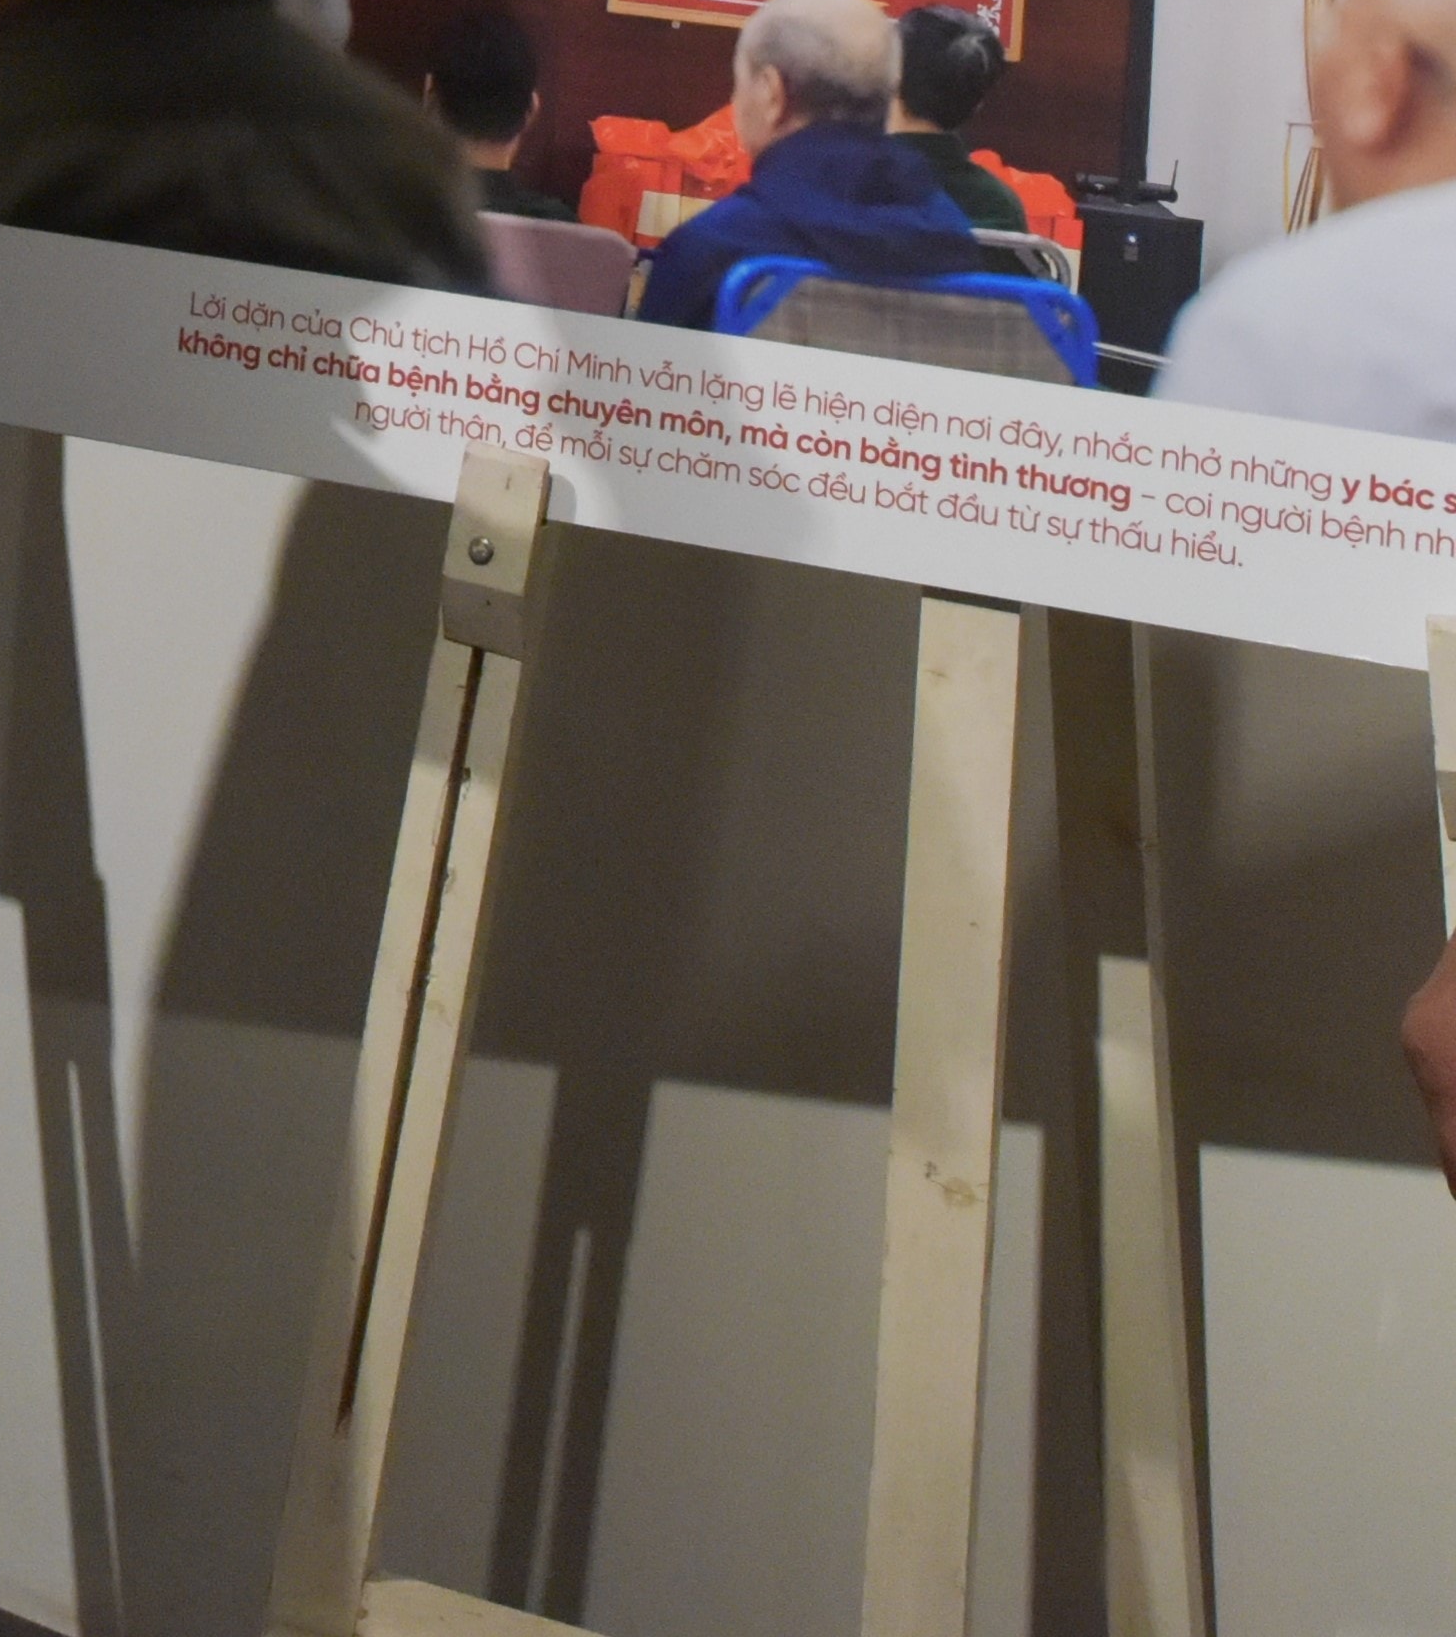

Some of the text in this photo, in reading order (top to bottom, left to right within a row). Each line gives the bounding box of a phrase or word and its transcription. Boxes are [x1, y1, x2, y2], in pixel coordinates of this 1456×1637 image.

[177, 326, 261, 371] không
[267, 344, 308, 372] chỉ
[312, 351, 381, 384] chữa
[387, 360, 458, 397] bệnh
[464, 372, 540, 416] bằng
[547, 389, 652, 428] chuyên
[659, 409, 731, 446] môn,
[740, 422, 789, 450] mà
[795, 429, 852, 461] còn
[859, 436, 941, 482] bằng
[949, 452, 1008, 486] tình
[1015, 463, 1131, 512] thương
[1165, 492, 1212, 519] coi
[1221, 500, 1312, 535] người
[1320, 509, 1406, 550] bệnh
[189, 290, 227, 320] Lời
[231, 299, 285, 332] dặn
[290, 308, 342, 339] của
[349, 316, 404, 349] Chủ
[410, 327, 461, 358] tịch
[467, 333, 507, 365] Hồ
[513, 341, 560, 373] Chí
[566, 349, 632, 385] Minh
[638, 359, 693, 394] vẫn
[700, 369, 765, 412] lặng
[772, 380, 797, 411] lẽ
[804, 386, 865, 424] hiện
[872, 399, 938, 436] diện
[946, 415, 992, 442] nơi
[998, 419, 1063, 458] đây,
[1073, 430, 1153, 467] nhắc
[1161, 444, 1222, 477] nhở
[1230, 455, 1332, 502] những
[1341, 476, 1361, 505] y
[1368, 473, 1434, 510] bác
[354, 401, 1243, 567] người thân, để mỗi sự chăm sóc đều bắt đầu từ sự thấu hiểu.
